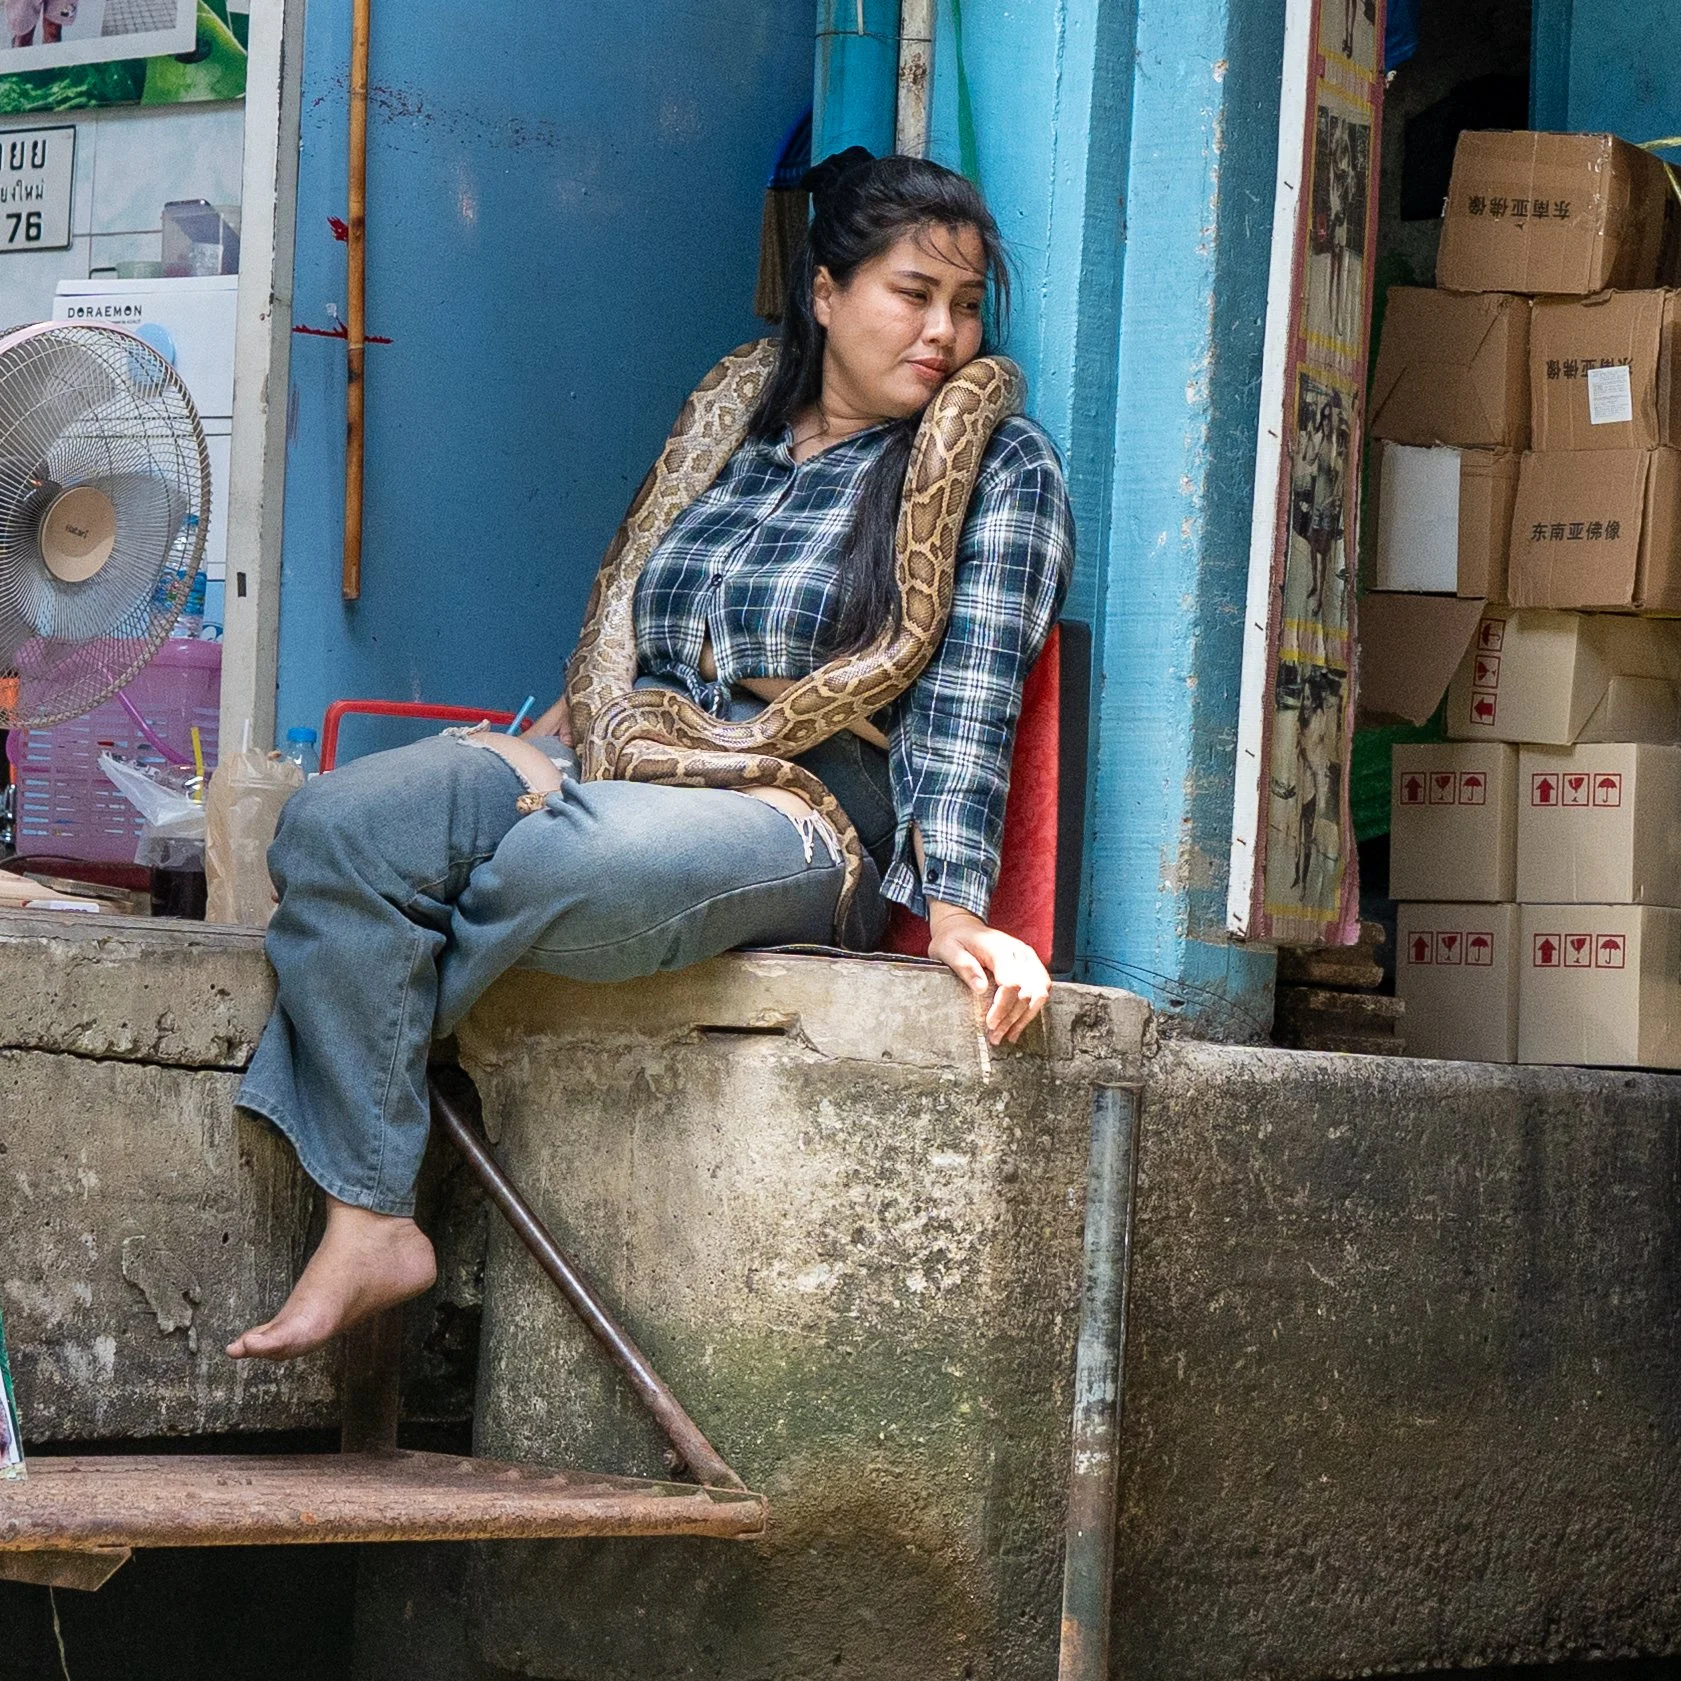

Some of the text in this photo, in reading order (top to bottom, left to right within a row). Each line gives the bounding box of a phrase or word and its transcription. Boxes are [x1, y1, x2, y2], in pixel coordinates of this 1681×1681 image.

[0, 139, 47, 171] ยย
[1468, 195, 1571, 220] 东南亚佛像
[6, 211, 42, 244] 76
[67, 305, 142, 319] DORAEMON
[1530, 520, 1621, 542] 东南亚佛像
